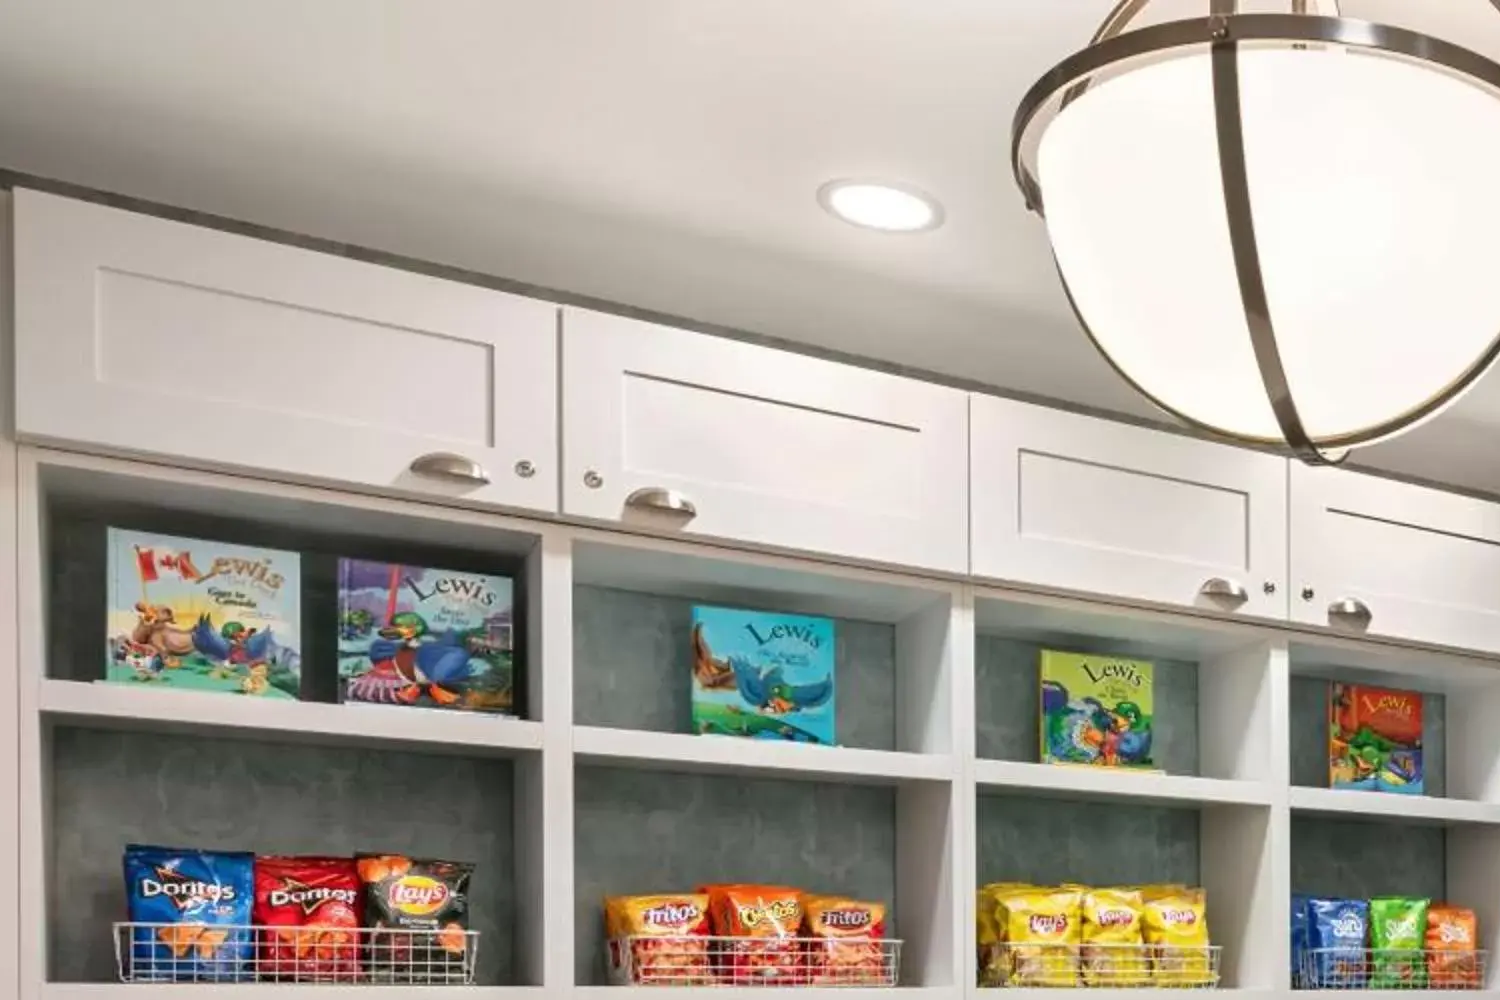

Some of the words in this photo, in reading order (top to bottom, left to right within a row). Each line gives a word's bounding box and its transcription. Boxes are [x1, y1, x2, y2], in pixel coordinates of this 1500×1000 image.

[405, 575, 497, 607] Lewis
[744, 622, 821, 650] Lewis
[1081, 662, 1142, 687] Lewis
[142, 879, 236, 901] Doritos
